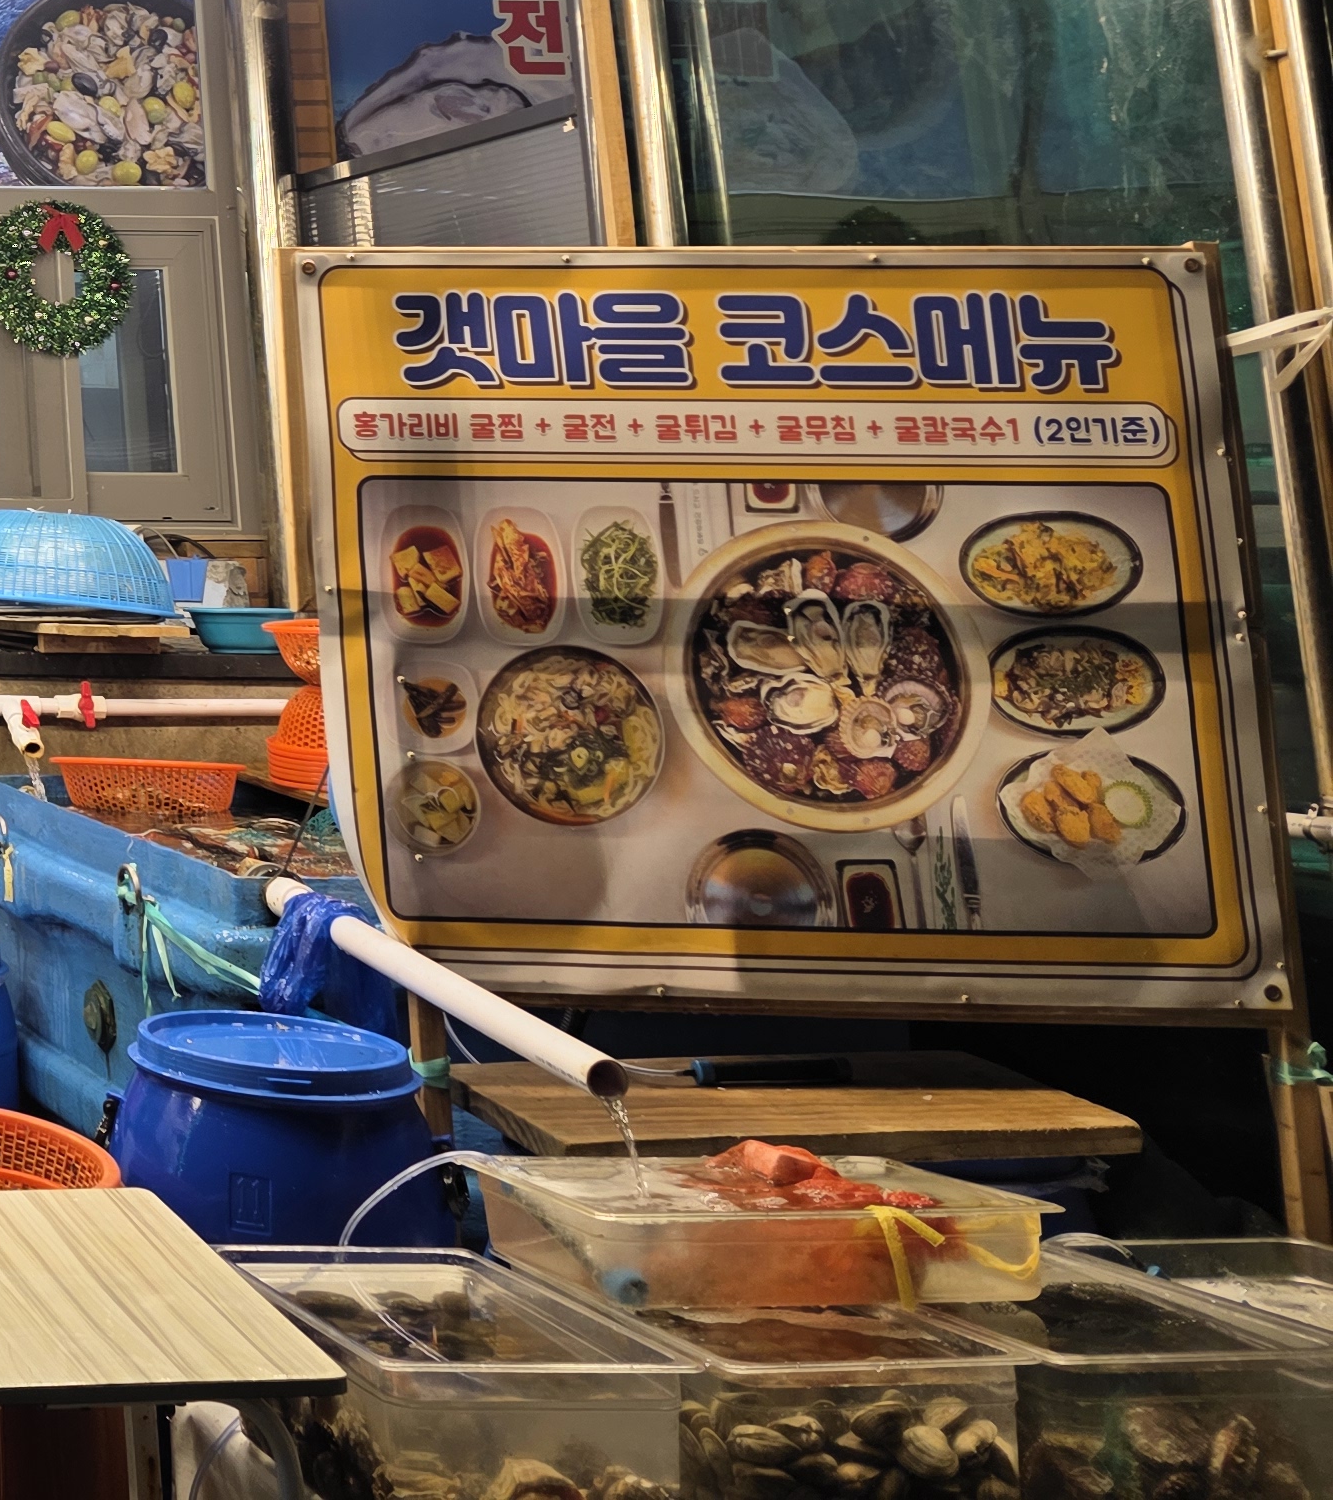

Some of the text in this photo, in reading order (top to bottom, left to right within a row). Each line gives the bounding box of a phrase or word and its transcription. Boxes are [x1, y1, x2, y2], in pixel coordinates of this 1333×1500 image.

[393, 290, 1121, 392] 갯마을 코스메뉴
[353, 411, 460, 441] 홍가리비
[469, 412, 524, 441] 굴찜
[535, 417, 552, 436] +
[562, 412, 617, 441] 굴전
[627, 418, 645, 436] +
[654, 413, 739, 443] 굴튀김
[748, 419, 766, 437] +
[776, 414, 857, 444] 굴무침
[866, 419, 883, 438] +
[1033, 415, 1162, 446] (2인기준)
